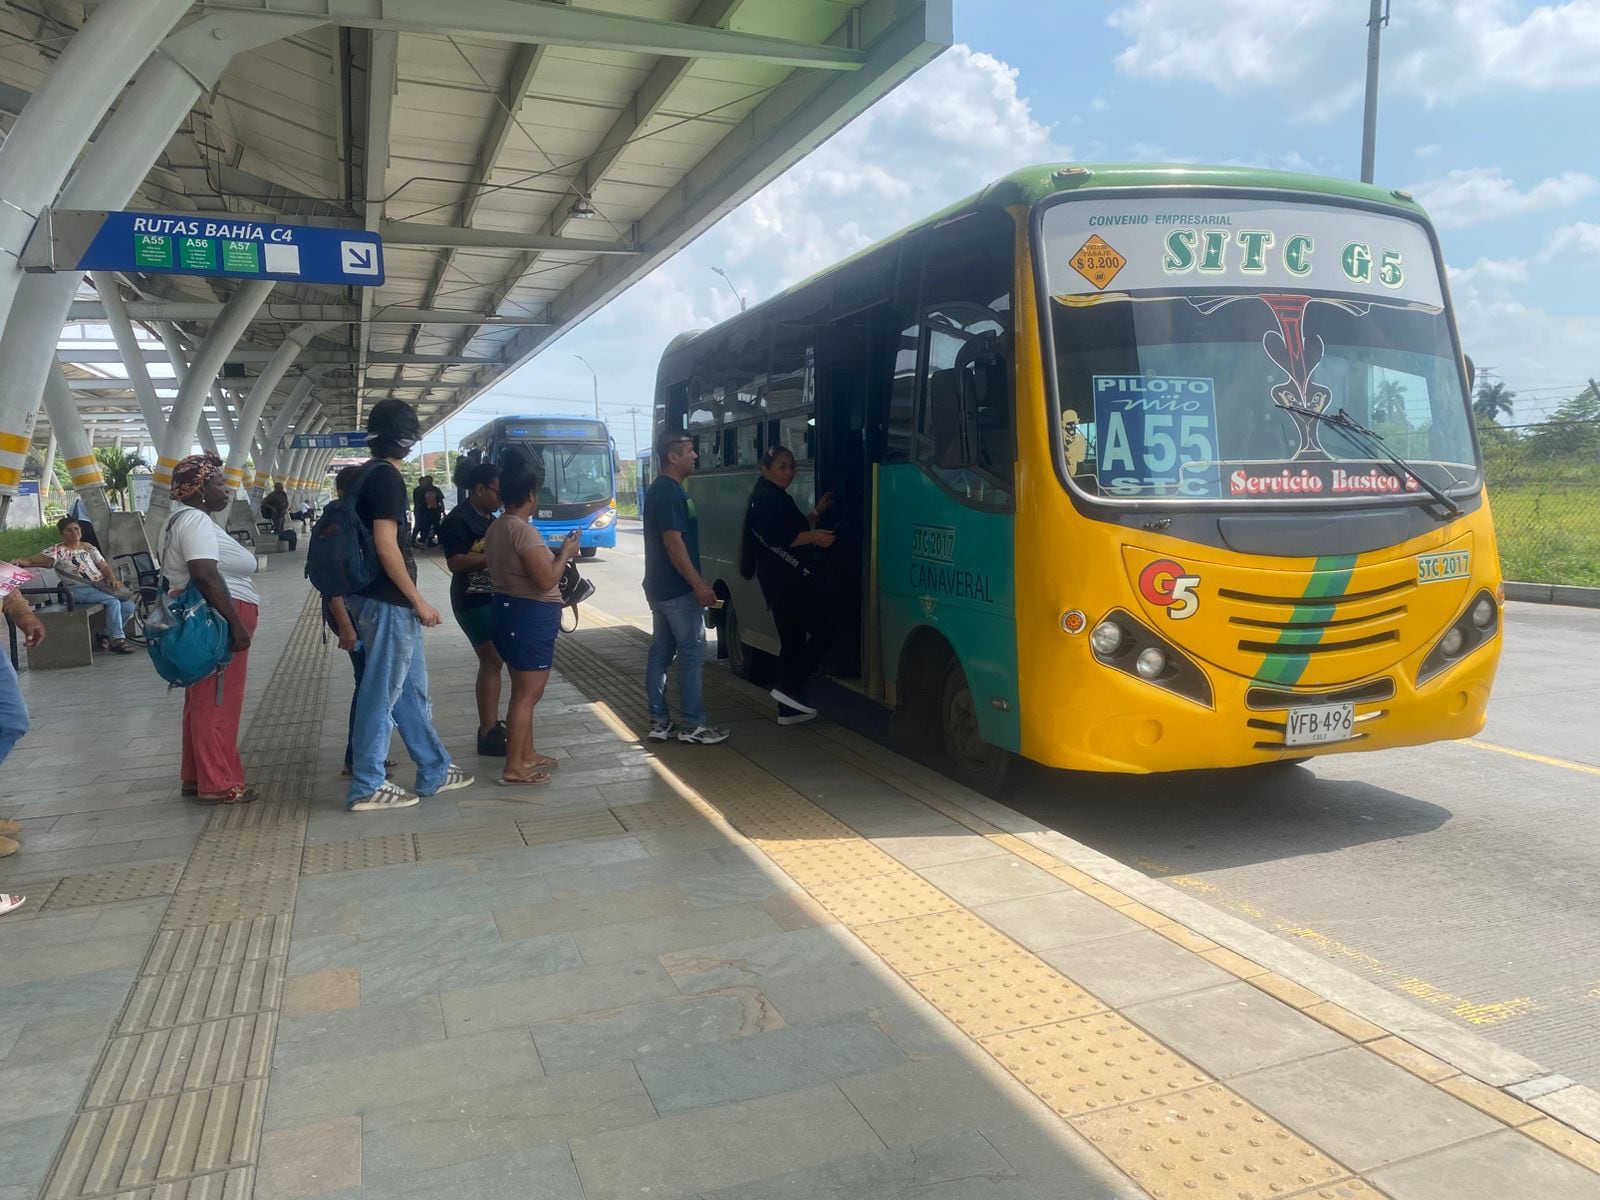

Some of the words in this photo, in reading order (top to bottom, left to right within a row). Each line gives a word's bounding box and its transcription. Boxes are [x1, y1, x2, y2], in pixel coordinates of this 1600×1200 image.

[133, 217, 199, 235] RUTAS
[205, 223, 264, 241] BAHÍA
[270, 228, 293, 243] C4
[1089, 214, 1149, 226] CONVENIO
[1155, 214, 1233, 226] EMPRESARIAL
[142, 235, 165, 245] A55
[186, 238, 208, 248] A56
[229, 241, 250, 250] A57
[1163, 228, 1315, 276] SITC
[1340, 240, 1406, 290] G5
[1098, 379, 1209, 393] PILOTO
[1111, 477, 1210, 496] STC
[1230, 469, 1323, 495] Servicio
[1331, 469, 1402, 492] Basico
[1418, 558, 1439, 578] STC
[1442, 554, 1469, 575] 2017
[910, 563, 994, 604] CANAVERAL
[1138, 559, 1201, 620] G5
